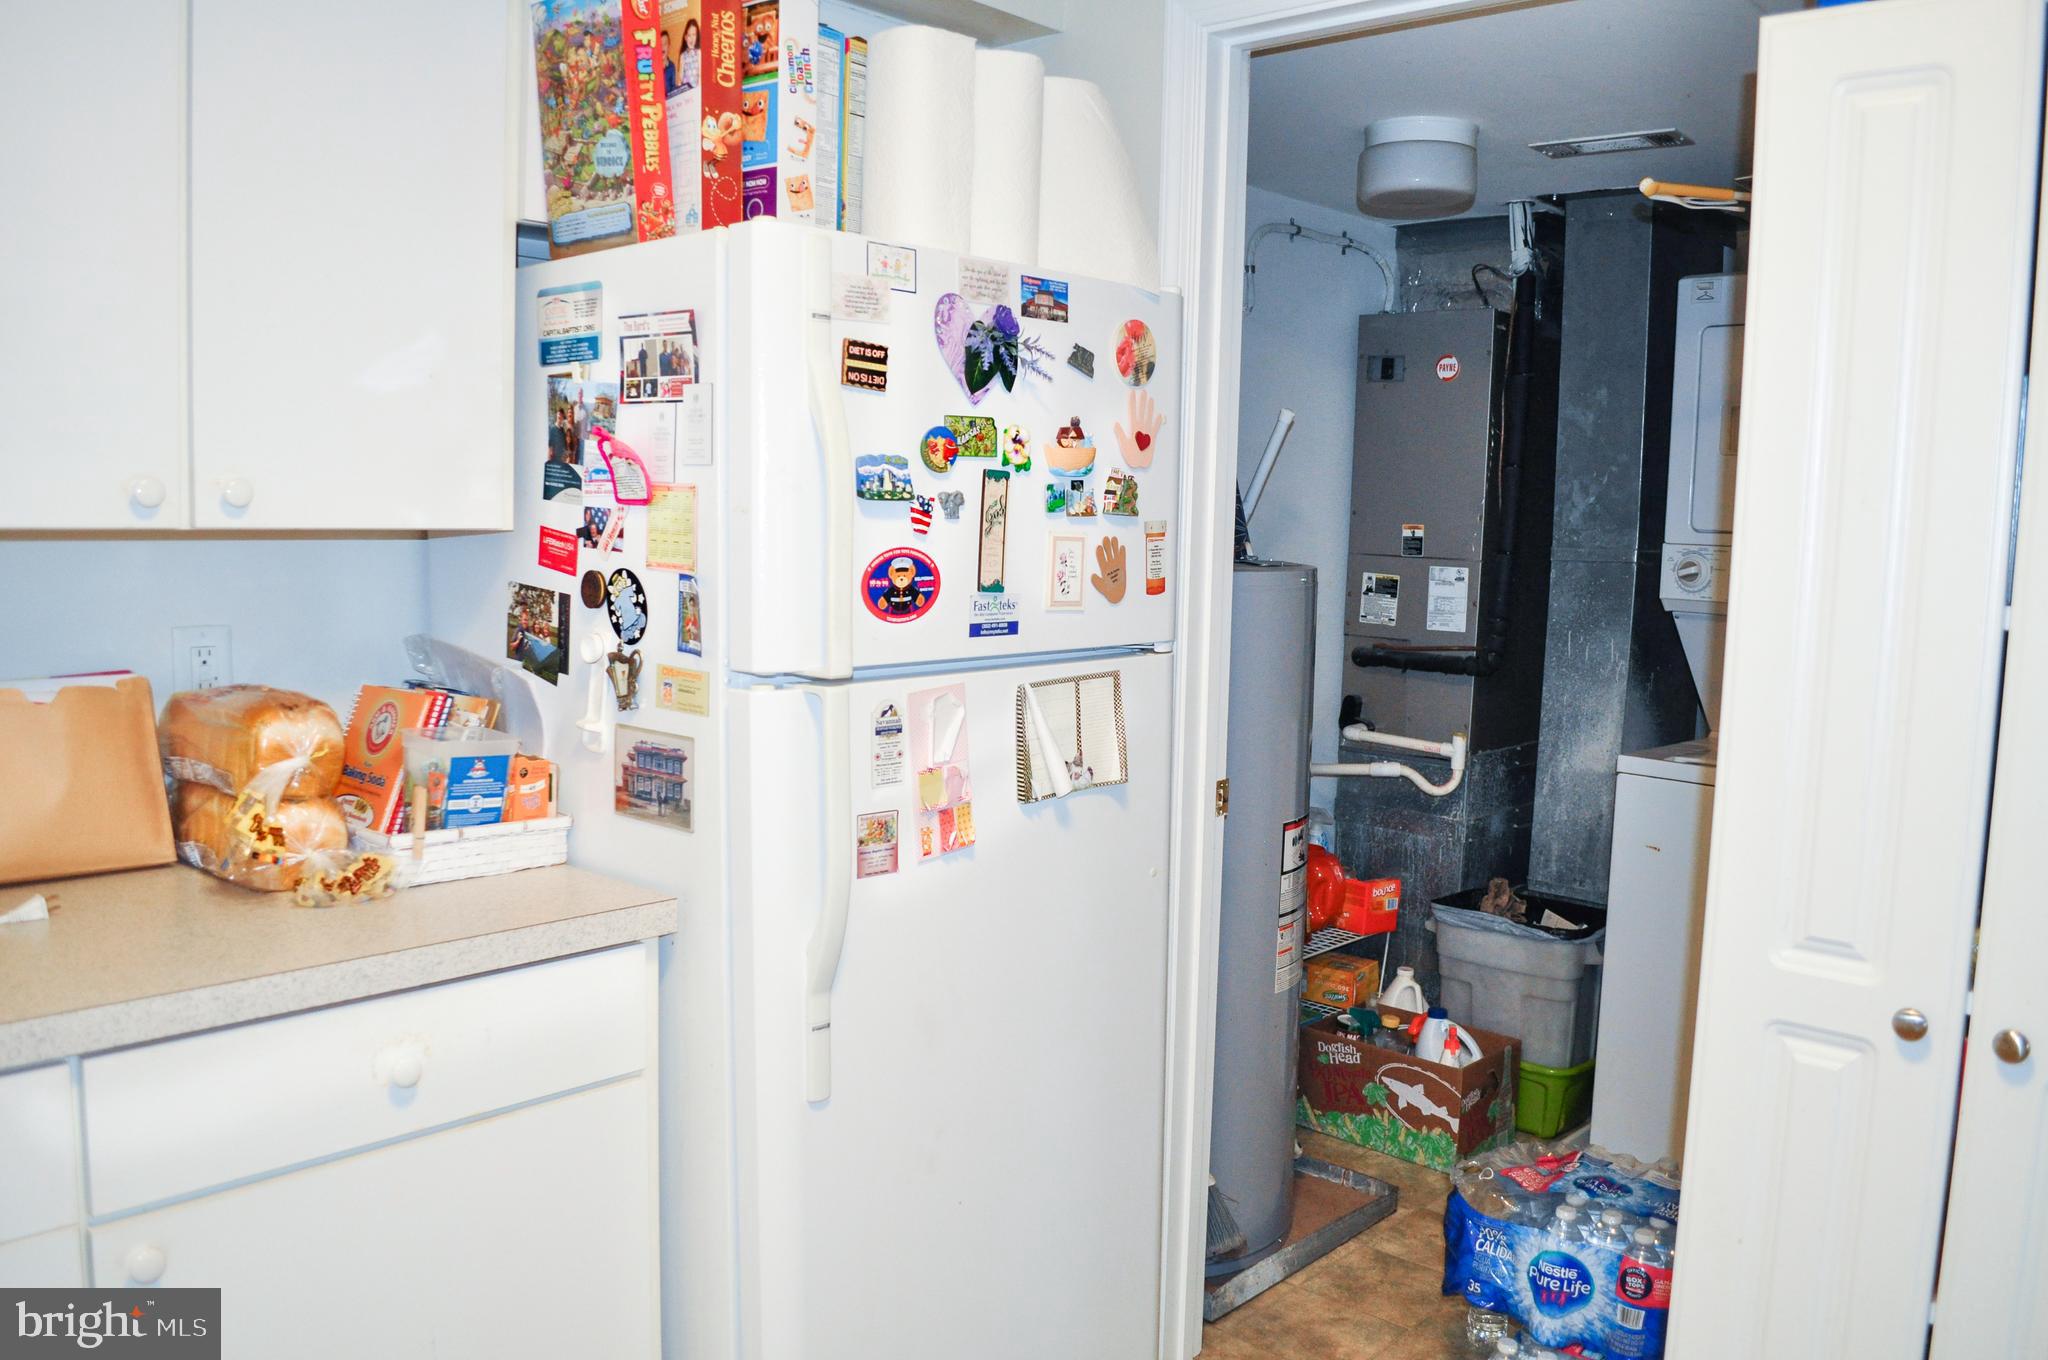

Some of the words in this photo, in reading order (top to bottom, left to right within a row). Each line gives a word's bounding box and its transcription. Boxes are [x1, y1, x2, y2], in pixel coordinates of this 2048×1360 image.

[711, 12, 719, 29] Nut
[711, 31, 720, 58] Honey
[716, 10, 735, 88] Cheerios
[786, 44, 797, 94] Cinnamon
[794, 55, 805, 85] Toast
[800, 47, 814, 94] Crunch
[849, 346, 865, 356] DIET
[865, 348, 871, 356] IS
[872, 349, 886, 359] OFF
[1439, 363, 1457, 373] PAYNE
[848, 371, 860, 382] ON
[868, 375, 885, 385] DIET
[343, 764, 367, 784] Baking
[368, 772, 385, 787] Soda
[1372, 883, 1396, 898] bounce
[1317, 1041, 1357, 1055] Dogfish
[1329, 1051, 1361, 1065] Head
[1467, 1279, 1481, 1293] 35
[1529, 1266, 1562, 1290] Pure
[1563, 1280, 1591, 1298] Life
[1626, 1276, 1642, 1285] BOX
[1628, 1282, 1645, 1290] TOPS
